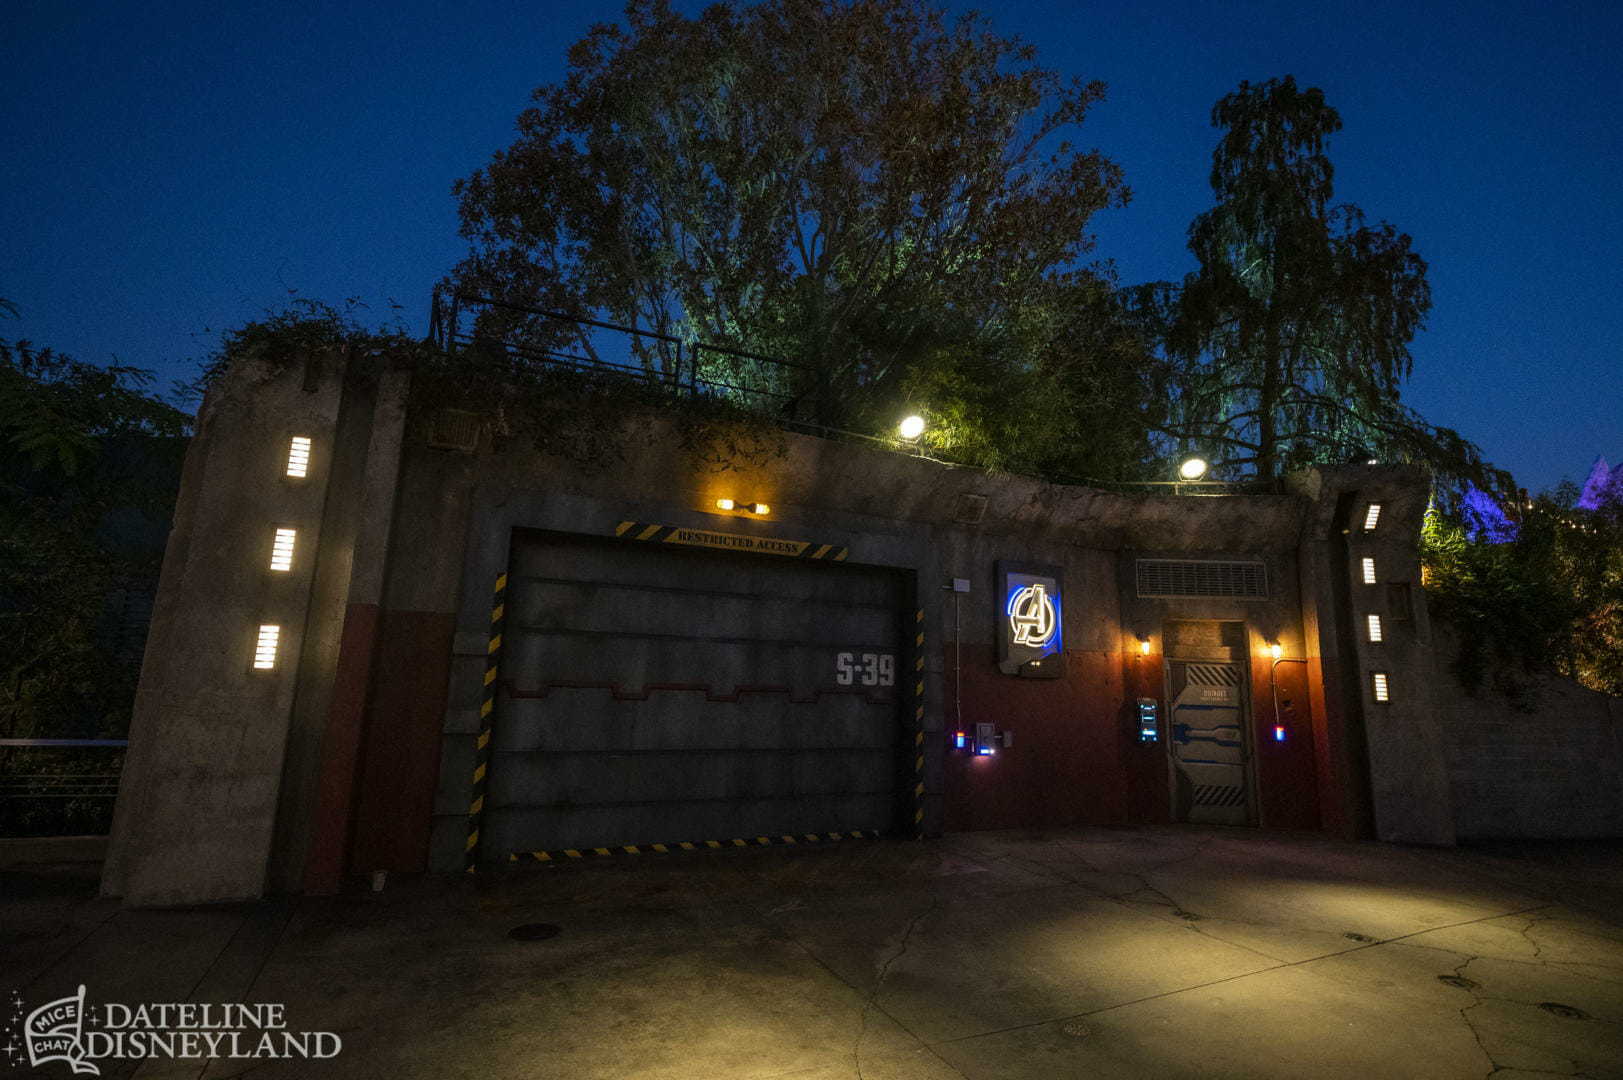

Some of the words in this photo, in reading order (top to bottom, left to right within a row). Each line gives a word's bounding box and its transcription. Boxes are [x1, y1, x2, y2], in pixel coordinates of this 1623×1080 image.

[679, 531, 753, 548] RESTRICTED
[757, 540, 798, 553] ACCESS
[836, 652, 895, 686] S-39
